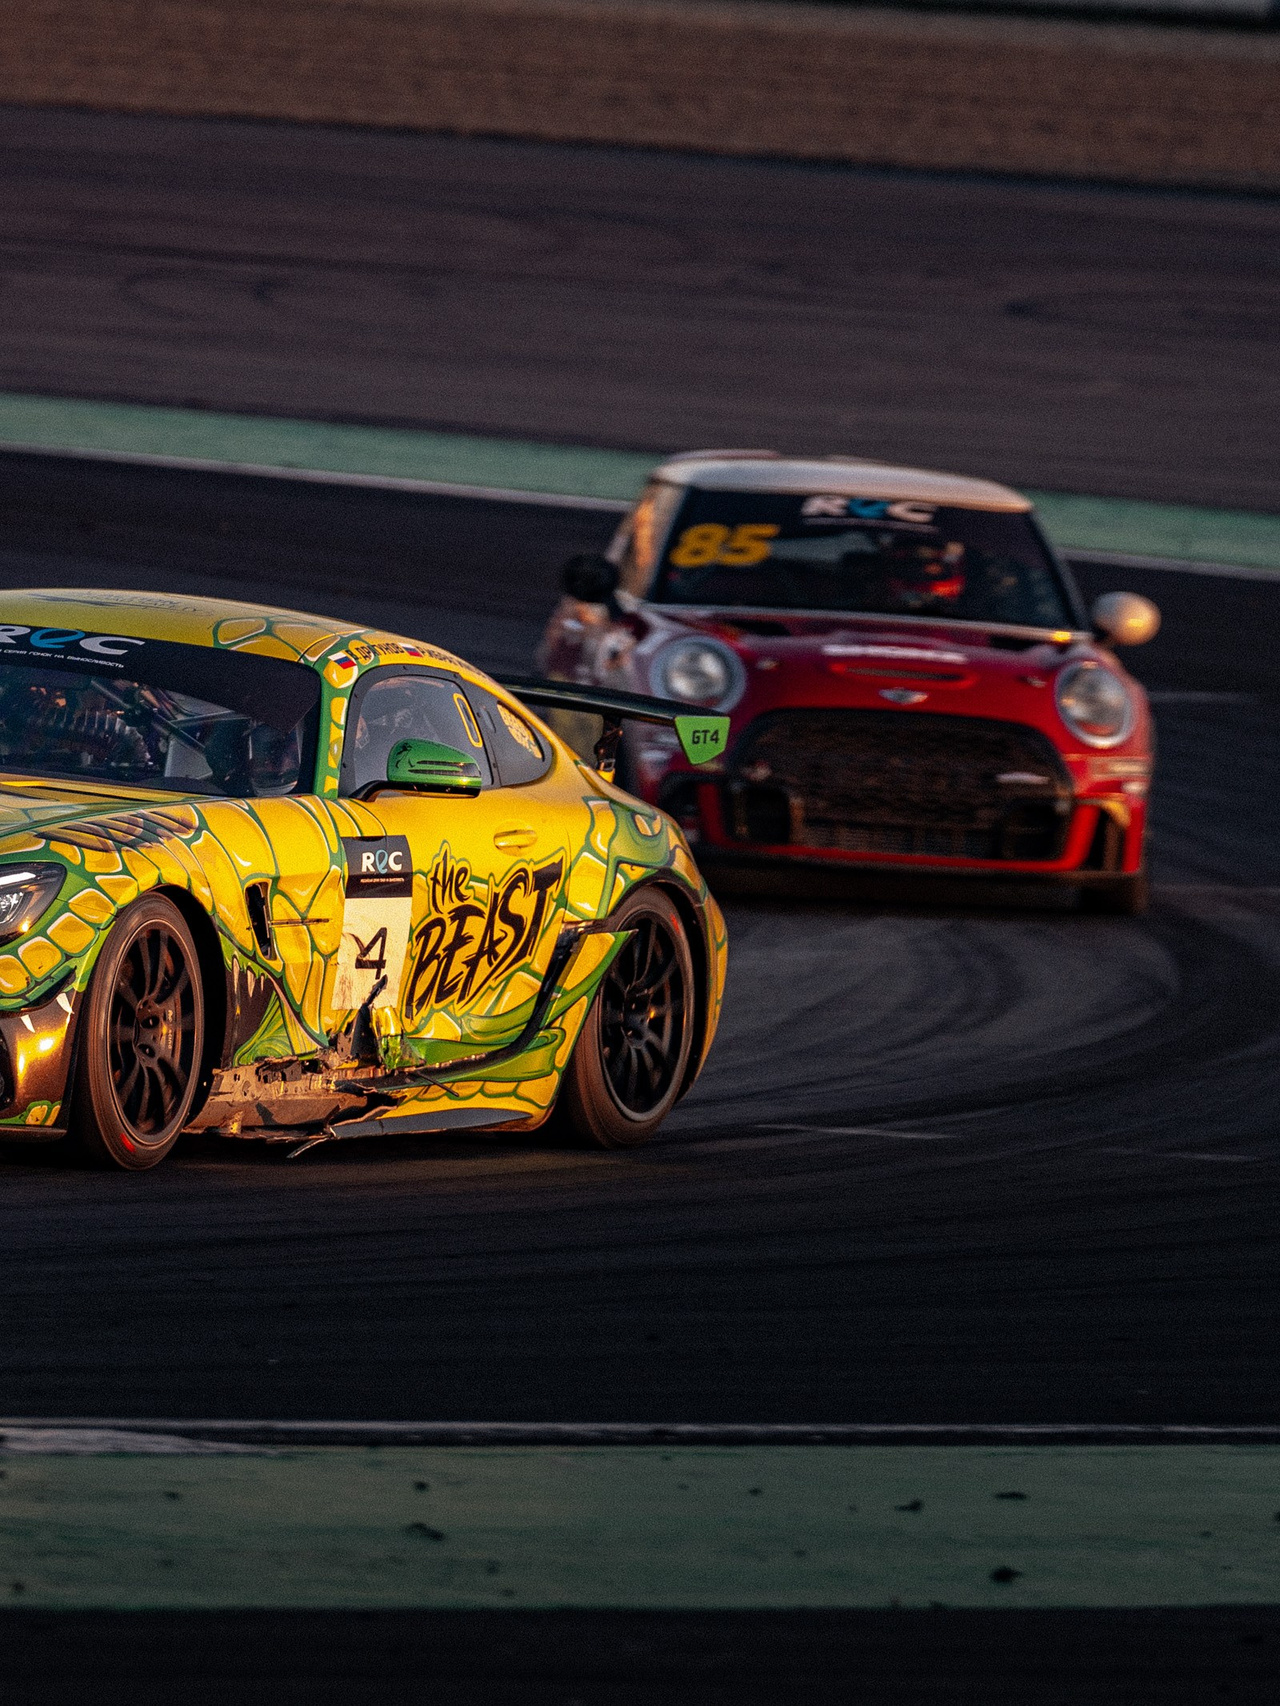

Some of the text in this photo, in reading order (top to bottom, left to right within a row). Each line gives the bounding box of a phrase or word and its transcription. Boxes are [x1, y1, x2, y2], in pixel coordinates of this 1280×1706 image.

[669, 523, 781, 567] 85
[692, 729, 719, 745] GT4
[431, 849, 470, 914] the
[355, 927, 388, 980] 4
[405, 856, 564, 1021] BEAST
